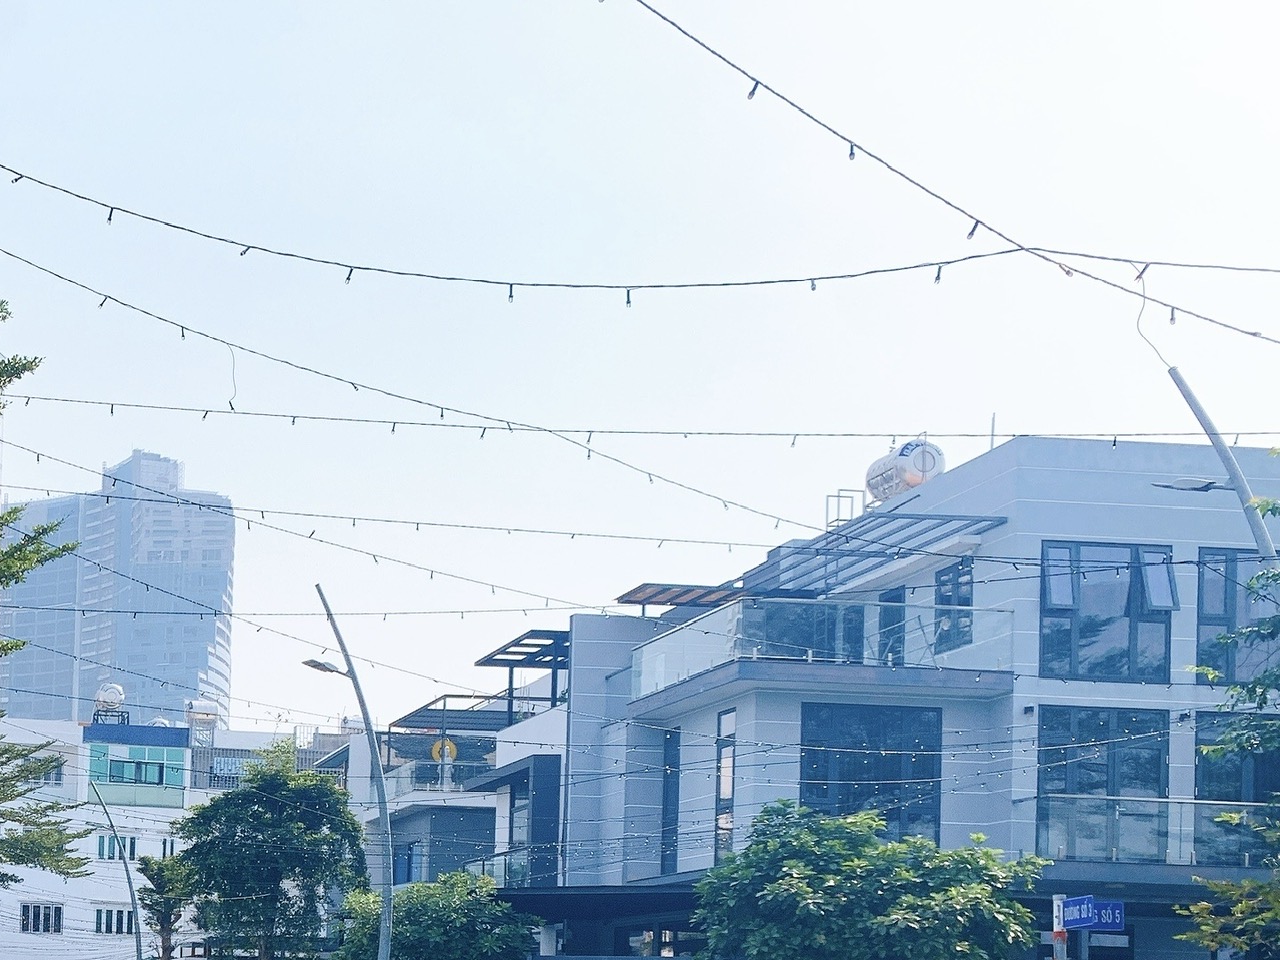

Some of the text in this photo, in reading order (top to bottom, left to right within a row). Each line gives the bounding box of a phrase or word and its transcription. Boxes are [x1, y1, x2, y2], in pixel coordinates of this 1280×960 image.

[1081, 898, 1088, 918] SỐ
[1101, 904, 1112, 923] SỐ
[1115, 909, 1121, 923] 5
